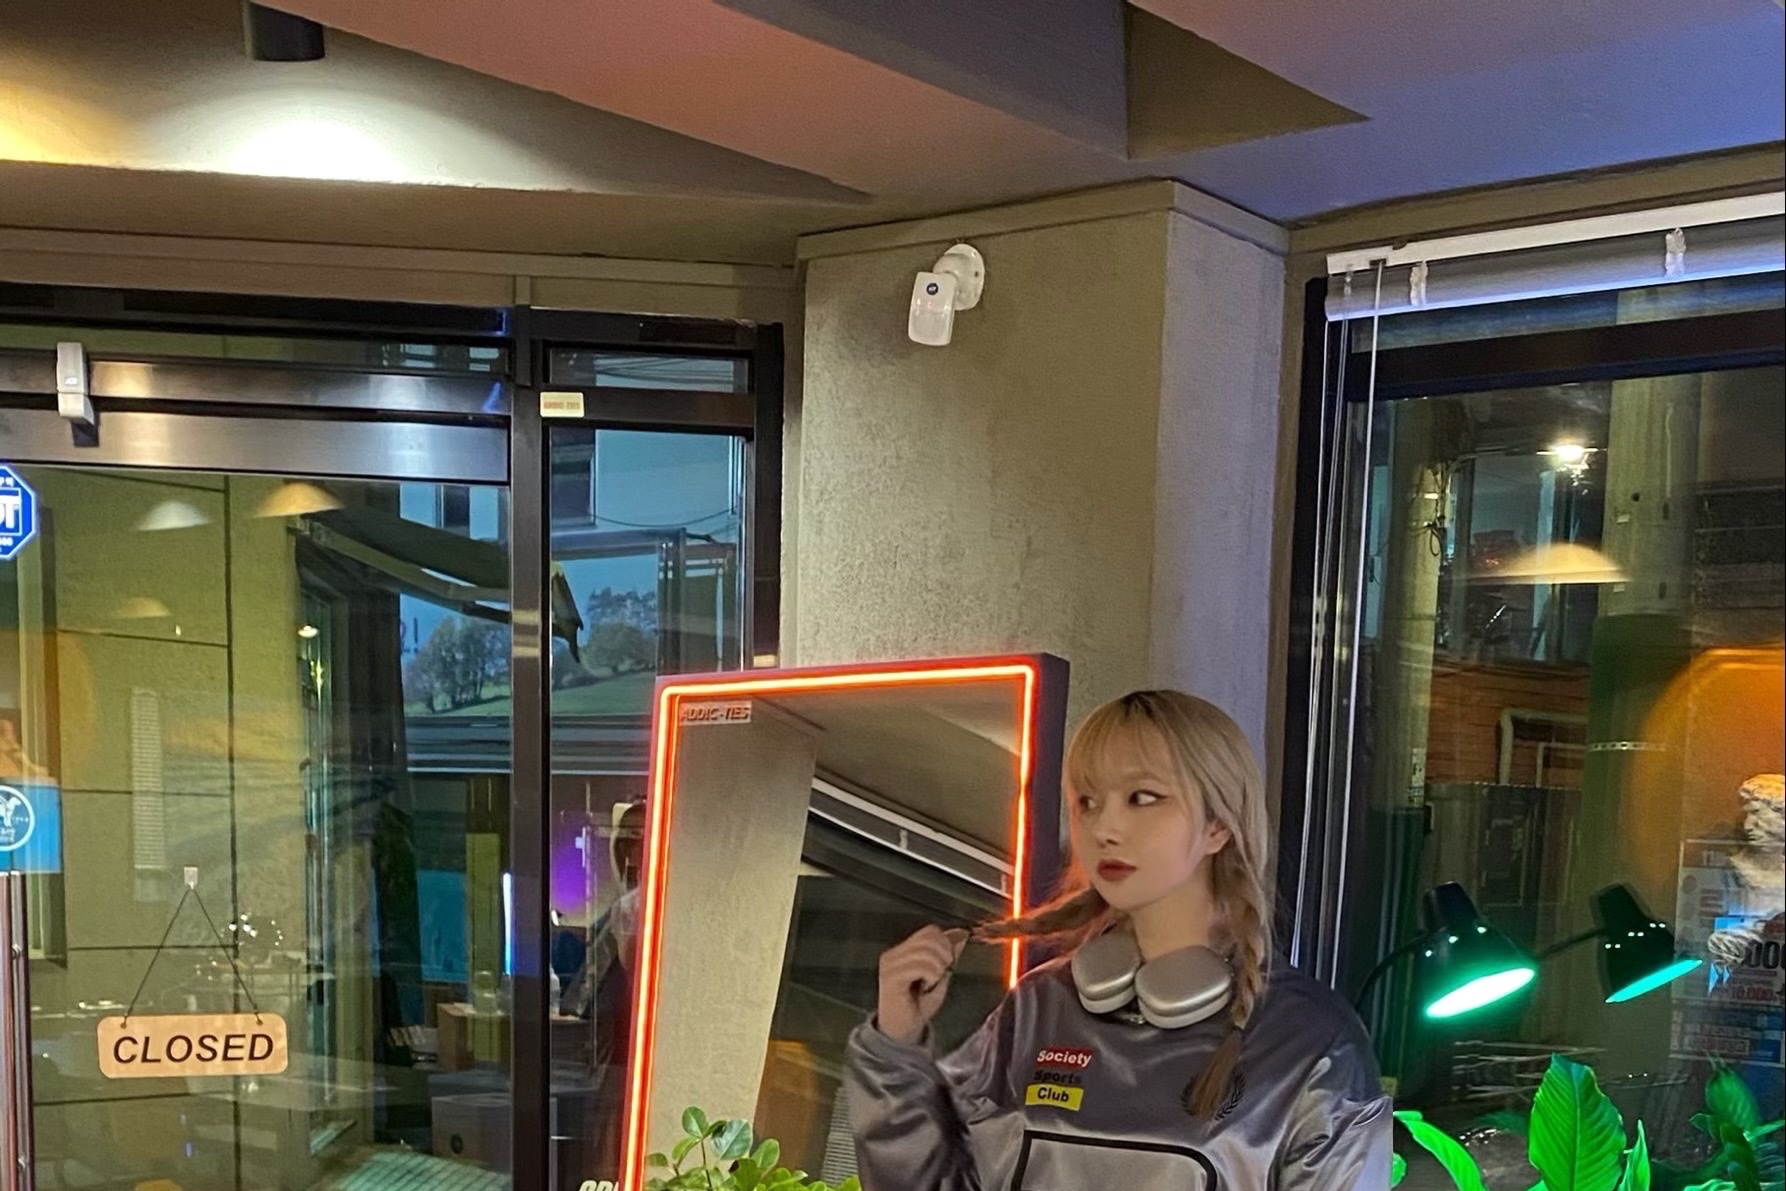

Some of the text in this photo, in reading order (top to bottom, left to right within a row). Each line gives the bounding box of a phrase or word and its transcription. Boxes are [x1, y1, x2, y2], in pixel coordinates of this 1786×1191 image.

[113, 1033, 274, 1064] CLOSED
[1037, 1049, 1093, 1067] Society
[1033, 1069, 1083, 1084] Sports
[1037, 1087, 1070, 1103] Club
